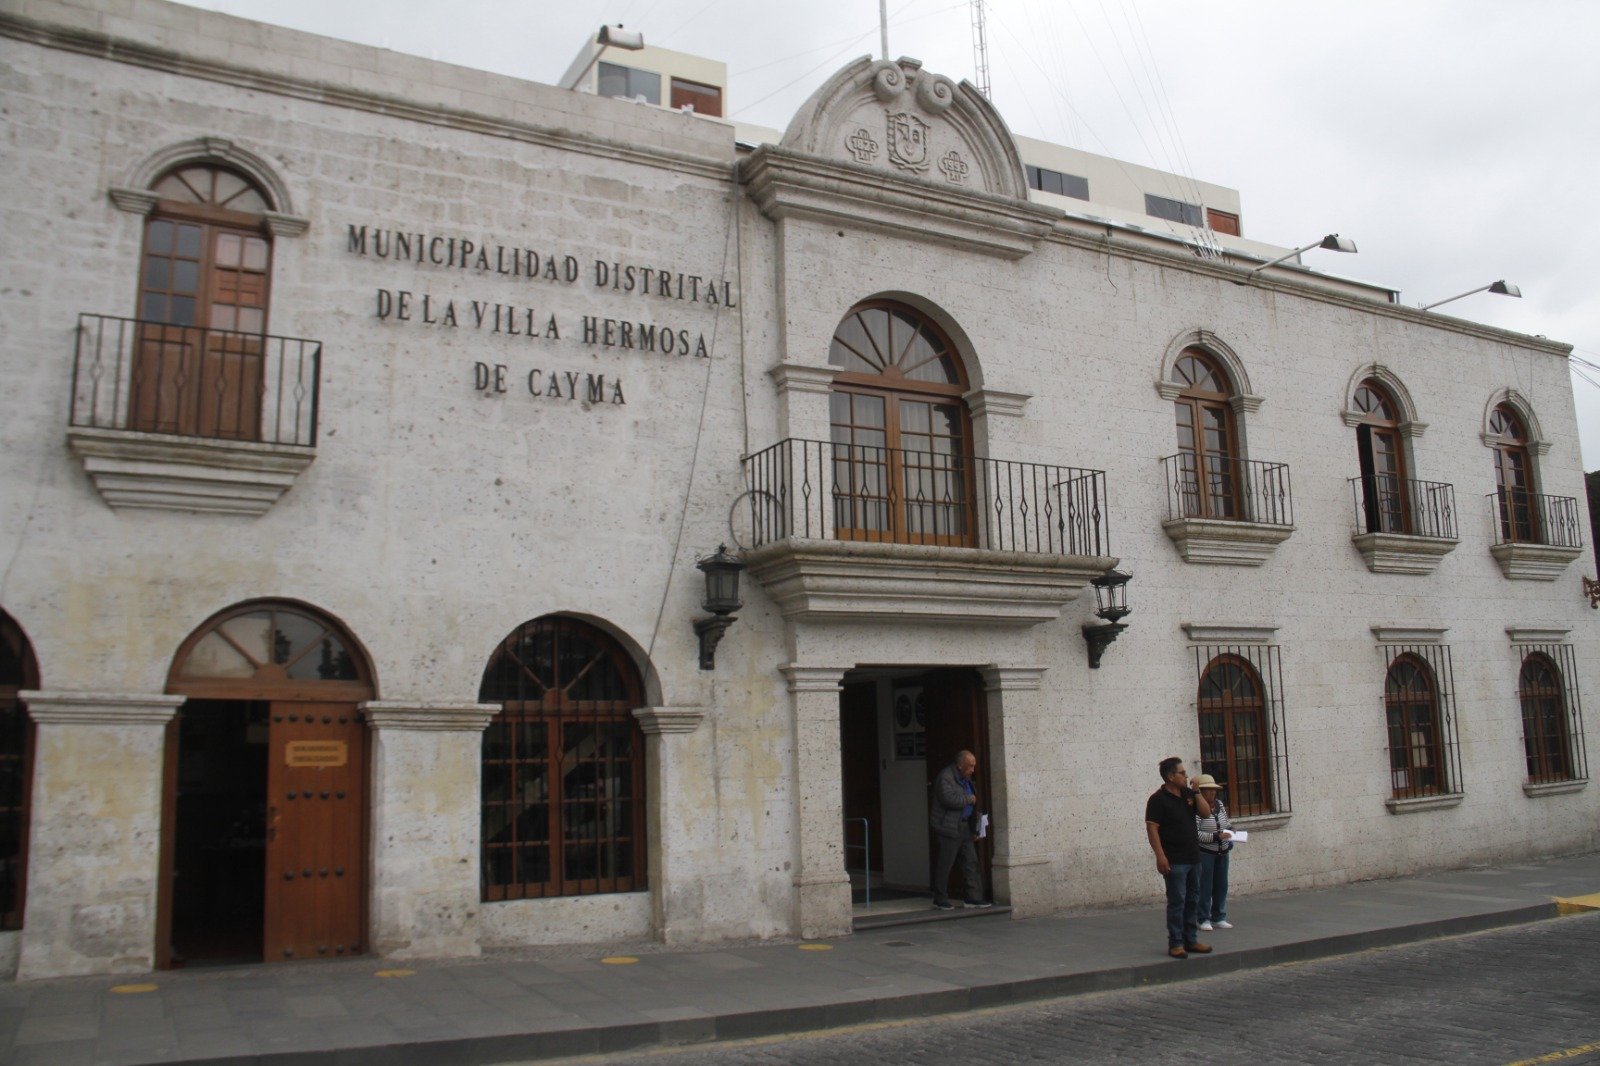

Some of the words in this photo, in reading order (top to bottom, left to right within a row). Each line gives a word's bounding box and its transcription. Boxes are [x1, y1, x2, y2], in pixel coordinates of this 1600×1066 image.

[851, 138, 877, 152] 1823
[943, 159, 967, 173] 1993
[347, 224, 579, 283] MUNICIPALIDAD
[595, 259, 736, 308] DISTRITAL
[376, 288, 411, 321] DE
[422, 294, 458, 328] LA
[472, 301, 560, 340] VILLA
[582, 315, 710, 359] HERMOSA
[474, 360, 508, 393] DE
[527, 367, 627, 405] CAYMA
